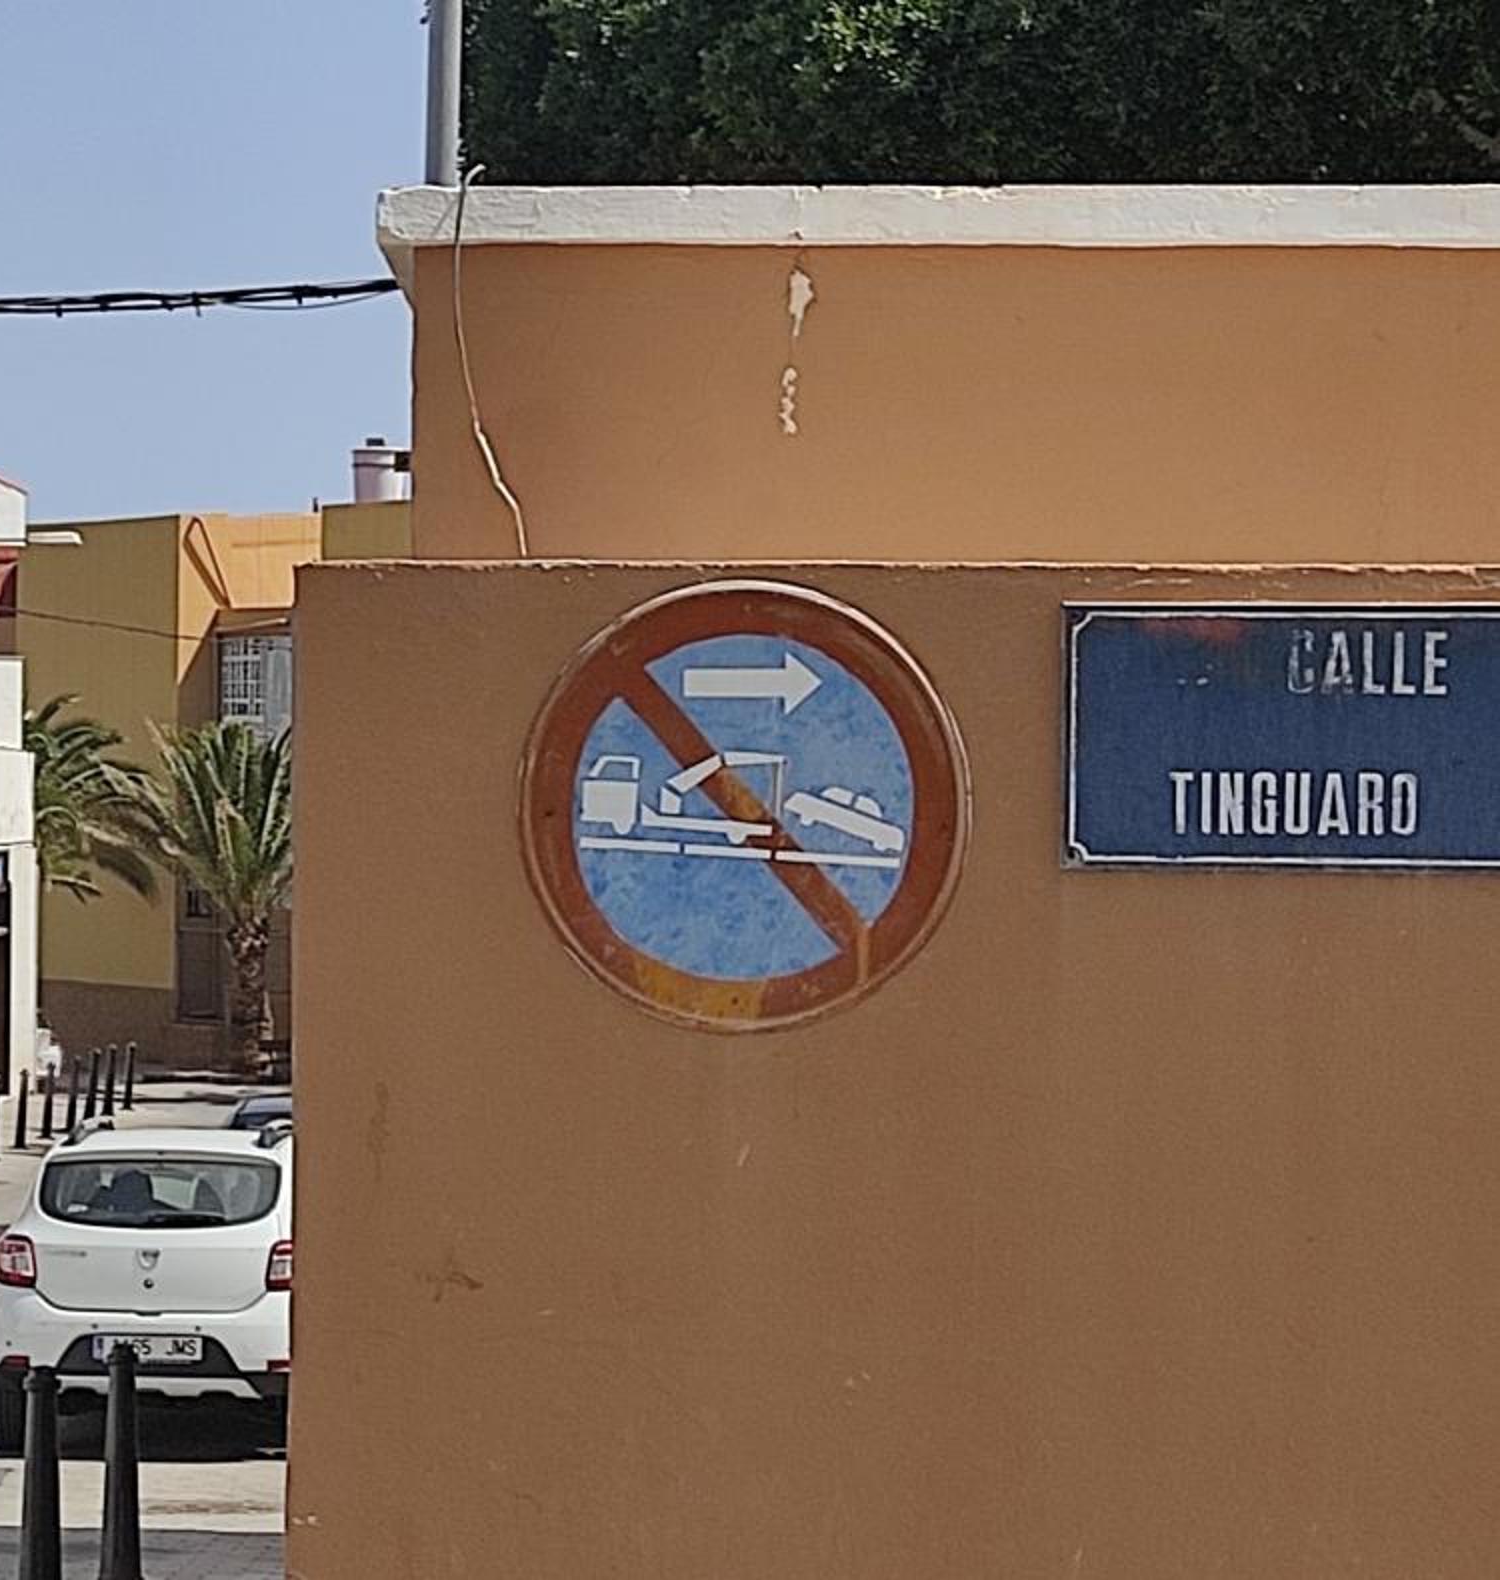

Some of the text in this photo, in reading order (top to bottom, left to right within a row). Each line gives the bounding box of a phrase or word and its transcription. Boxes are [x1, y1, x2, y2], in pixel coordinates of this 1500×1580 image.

[1286, 629, 1450, 696] CALLE
[1169, 771, 1419, 837] TINGUARO
[113, 1338, 197, 1357] 65 JMS
